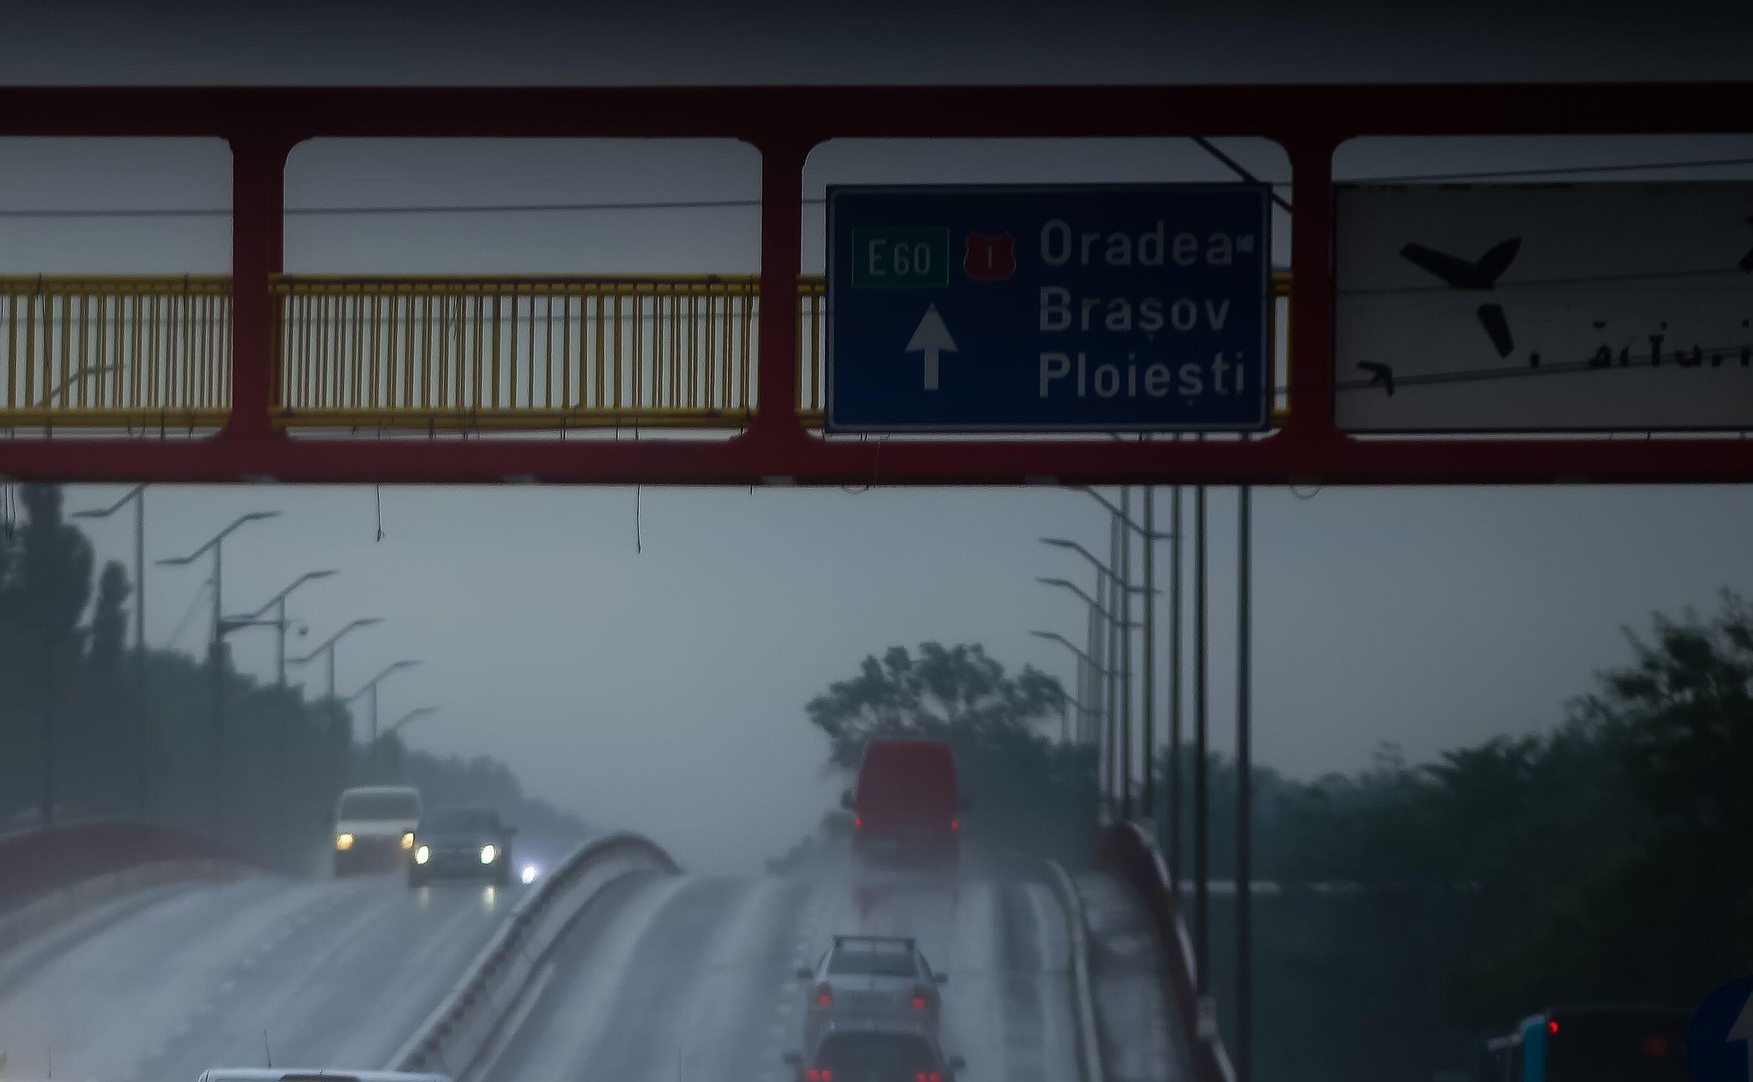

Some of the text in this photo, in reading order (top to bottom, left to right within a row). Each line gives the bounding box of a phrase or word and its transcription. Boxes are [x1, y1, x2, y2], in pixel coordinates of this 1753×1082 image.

[1039, 218, 1233, 267] Oradea
[1039, 285, 1231, 342] Brașov
[1039, 351, 1246, 405] Ploiești
